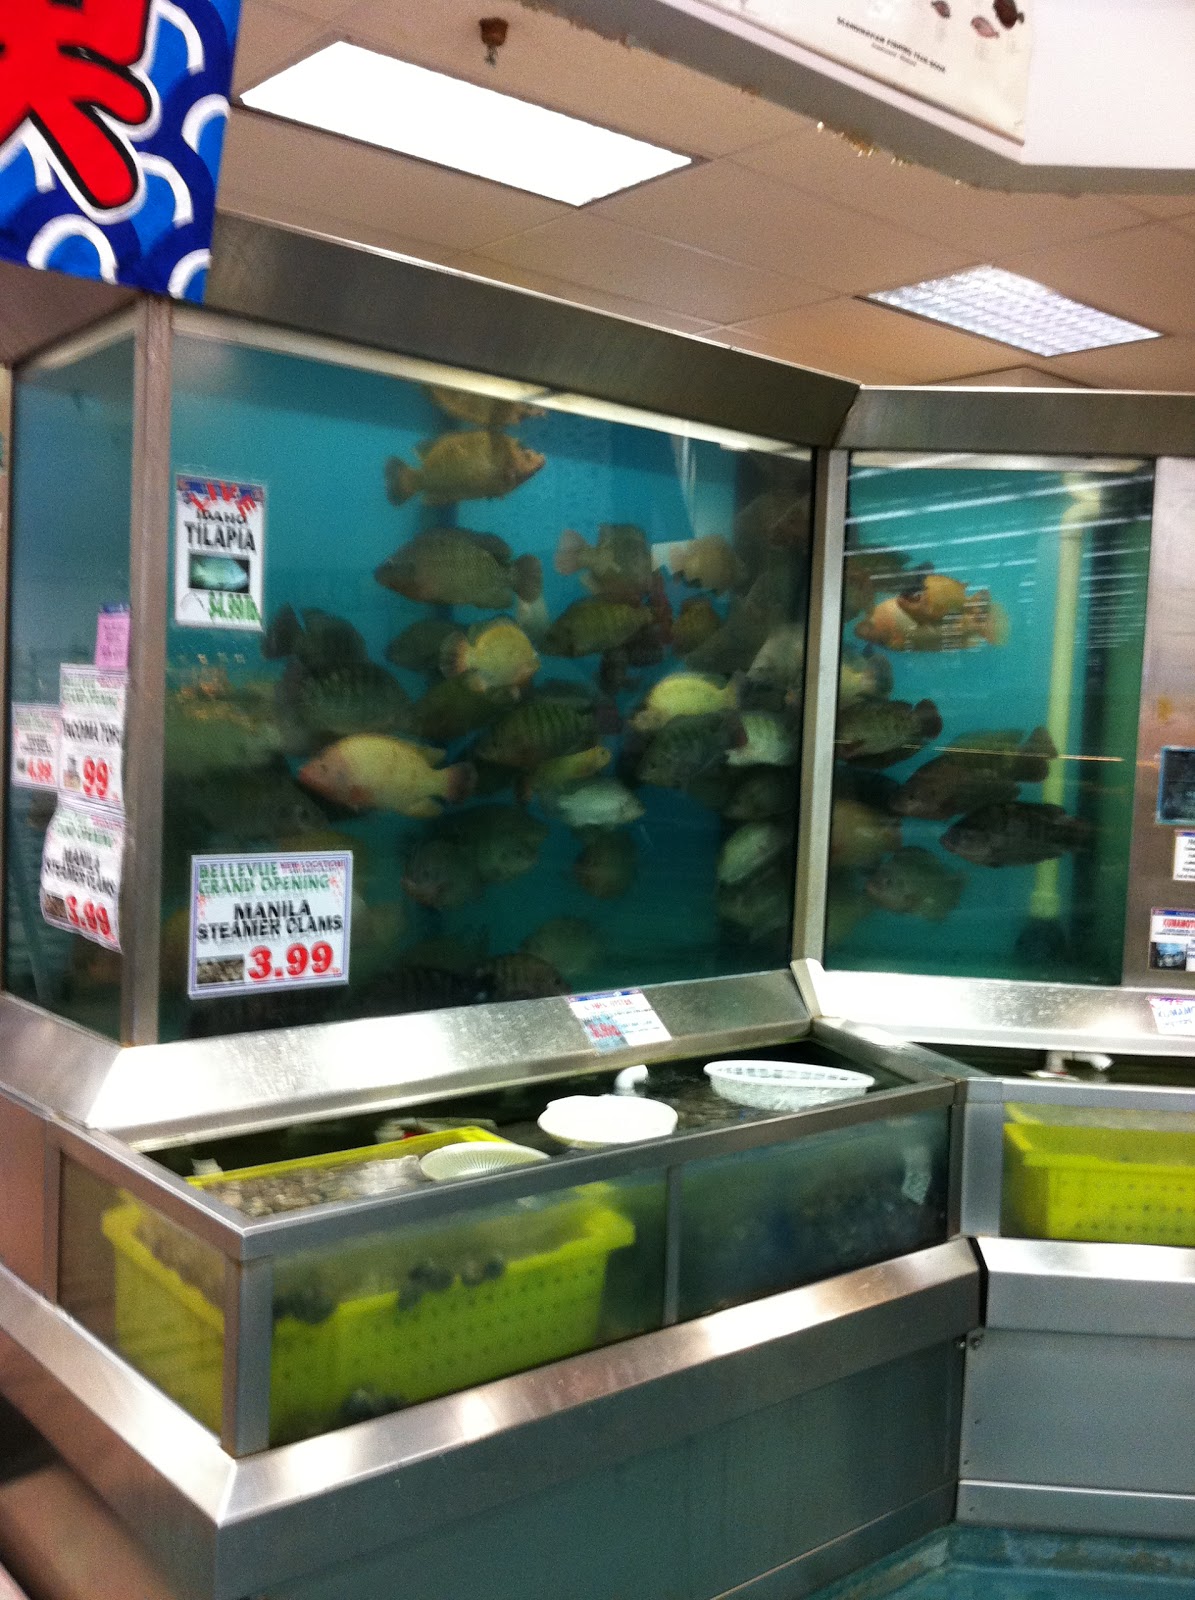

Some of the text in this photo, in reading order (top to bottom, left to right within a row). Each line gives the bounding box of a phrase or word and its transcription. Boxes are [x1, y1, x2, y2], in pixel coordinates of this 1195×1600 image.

[184, 521, 257, 551] TILAPIA
[200, 862, 278, 878] BELLEVUE
[200, 874, 330, 894] GRAND OPENING
[234, 899, 312, 920] MANILA
[198, 915, 343, 940] STEAMER CLAMS
[248, 940, 334, 980] 3.99
